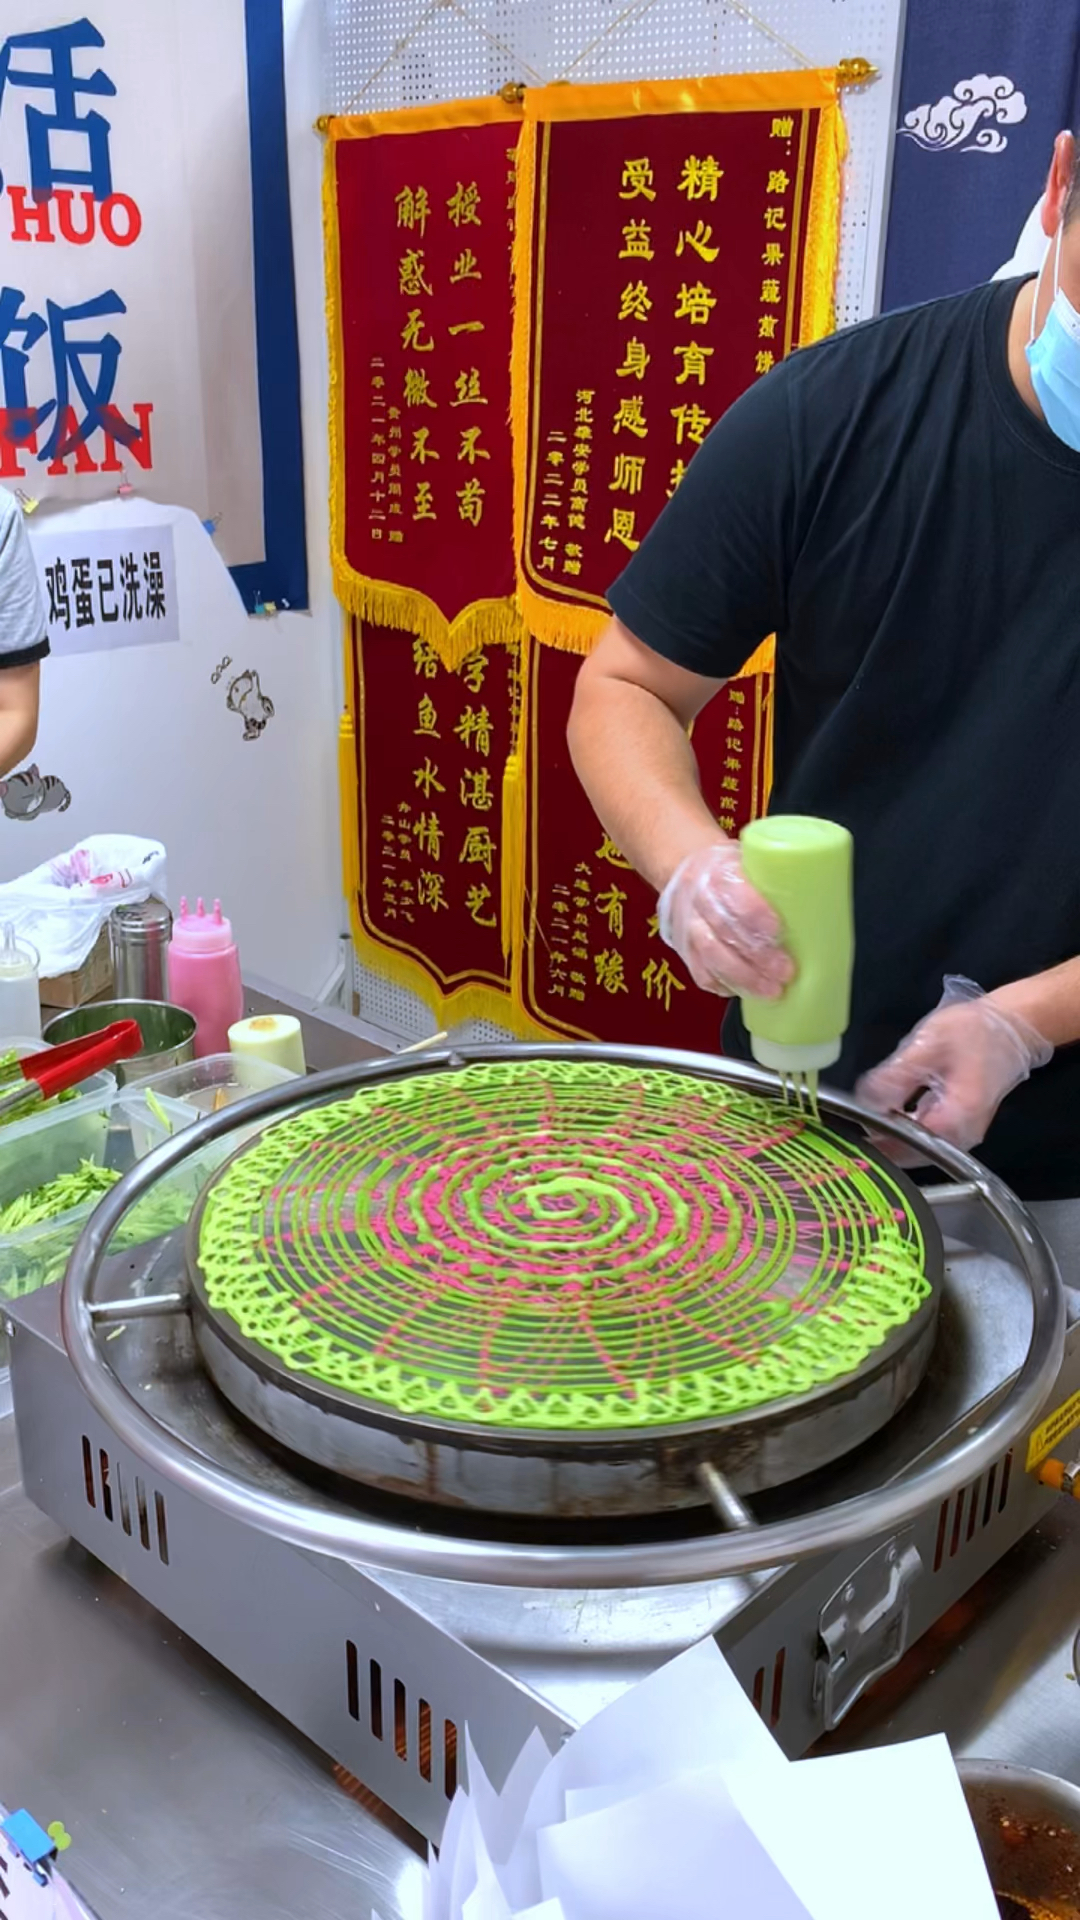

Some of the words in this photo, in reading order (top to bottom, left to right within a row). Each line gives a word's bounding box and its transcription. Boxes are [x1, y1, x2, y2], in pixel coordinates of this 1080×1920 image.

[7, 186, 141, 247] HUO
[0, 286, 142, 462] 饭
[395, 183, 440, 522] 解惑无微不至
[446, 181, 491, 527] 授业一丝不苟
[604, 157, 657, 552] 受益终身感师恩
[667, 154, 725, 499] 精心培育传
[0, 403, 153, 478] FAN
[536, 430, 568, 572] 二零二二年七月
[45, 552, 166, 631] 鸡蛋已洗澡
[640, 912, 687, 1012] 价
